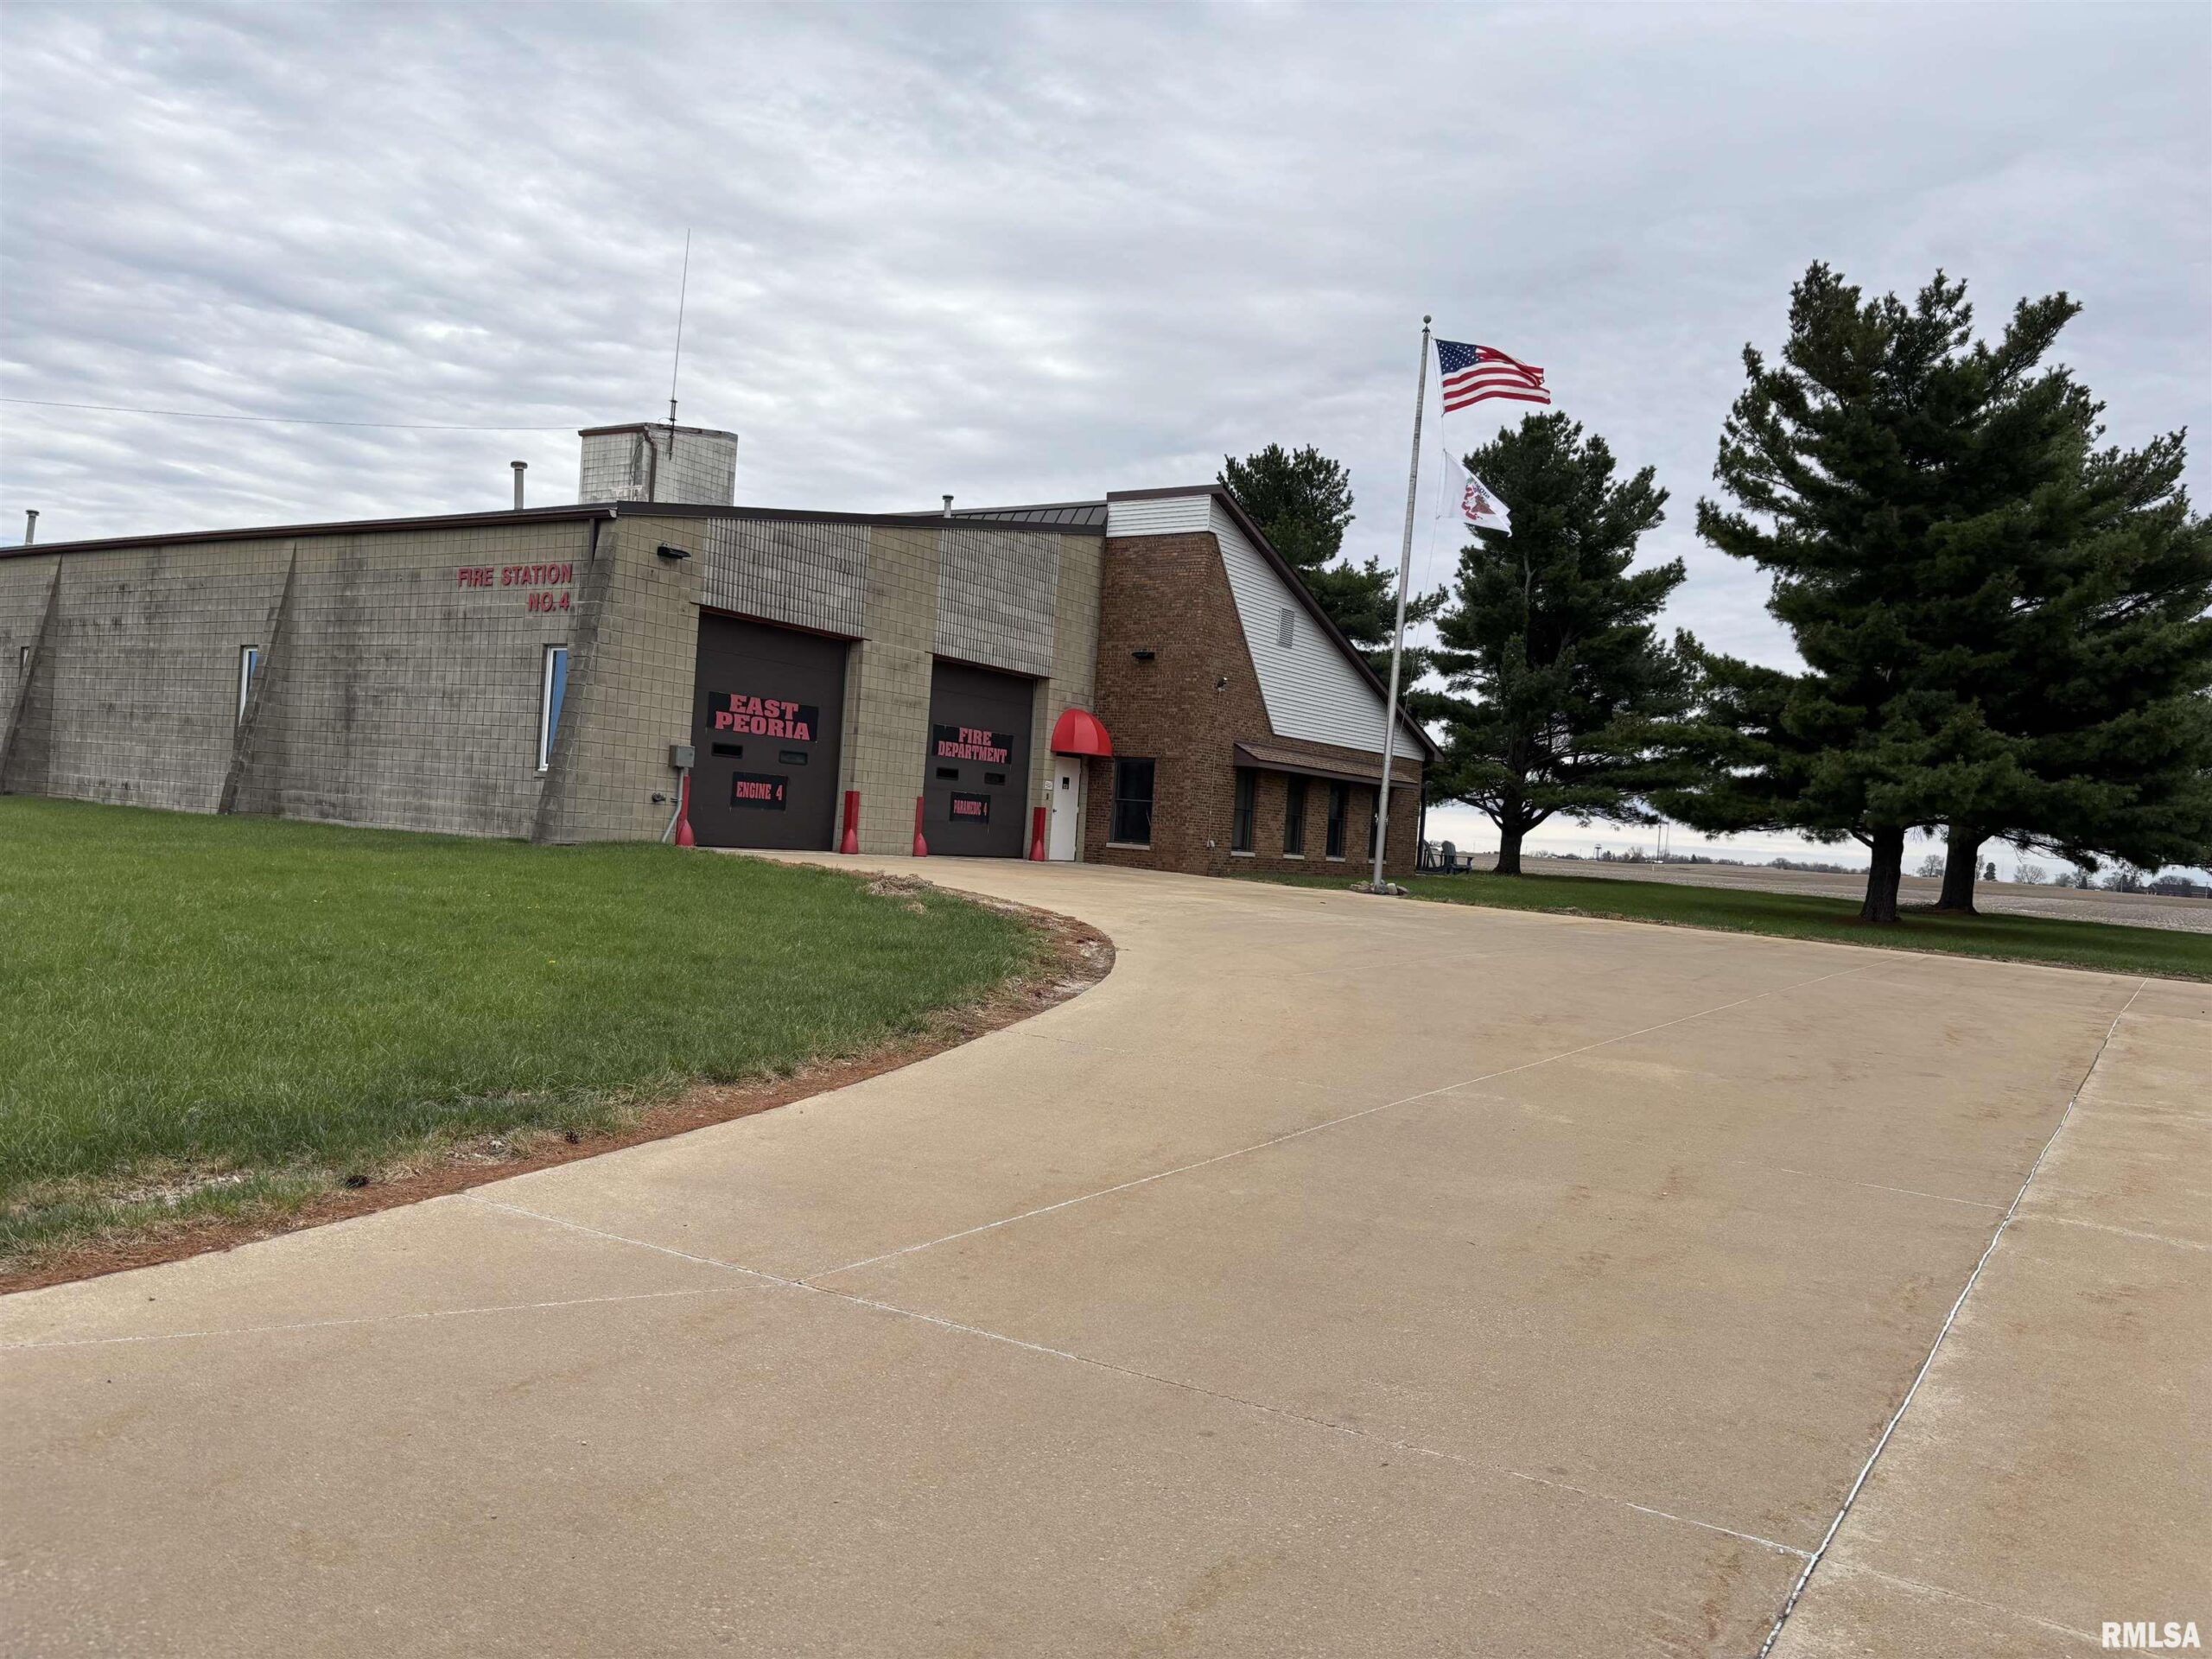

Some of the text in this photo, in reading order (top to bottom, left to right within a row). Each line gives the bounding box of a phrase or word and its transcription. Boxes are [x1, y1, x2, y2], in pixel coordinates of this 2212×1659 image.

[457, 563, 573, 587] FIRE STATION
[729, 693, 799, 720] EAST
[715, 710, 810, 741] PEORIA
[958, 727, 992, 746] FIRE
[938, 741, 1007, 764] DEPARTMENT
[736, 781, 783, 801] ENGINE 4
